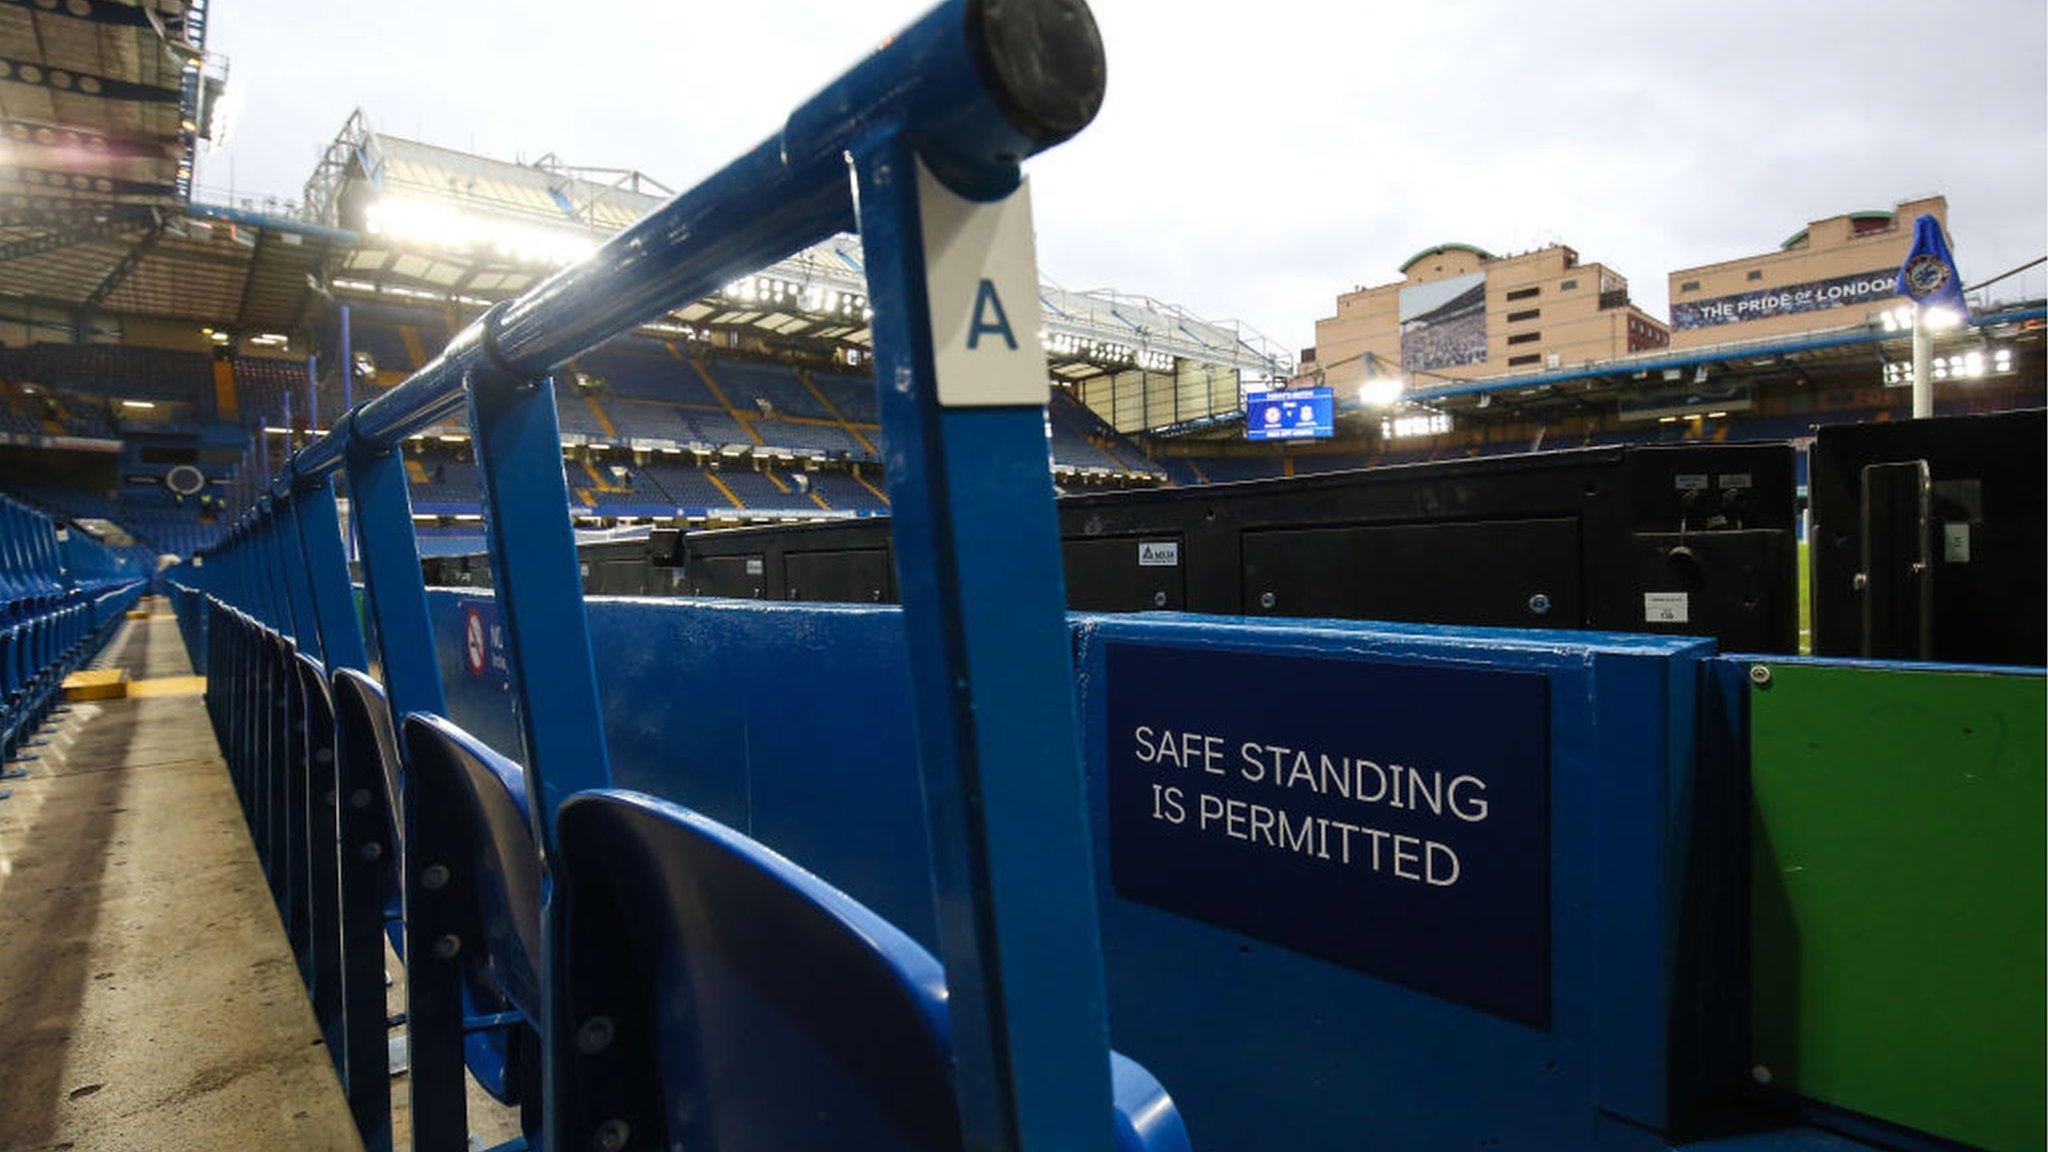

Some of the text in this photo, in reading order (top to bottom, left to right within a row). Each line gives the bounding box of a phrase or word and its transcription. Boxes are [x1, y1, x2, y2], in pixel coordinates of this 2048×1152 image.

[967, 278, 1018, 349] A
[1701, 302, 1733, 318] THE
[1737, 294, 1791, 313] PRIDE
[1795, 291, 1812, 302] OF
[1135, 726, 1489, 822] SAFE STANDING
[1153, 784, 1461, 887] IS PERMITTED
